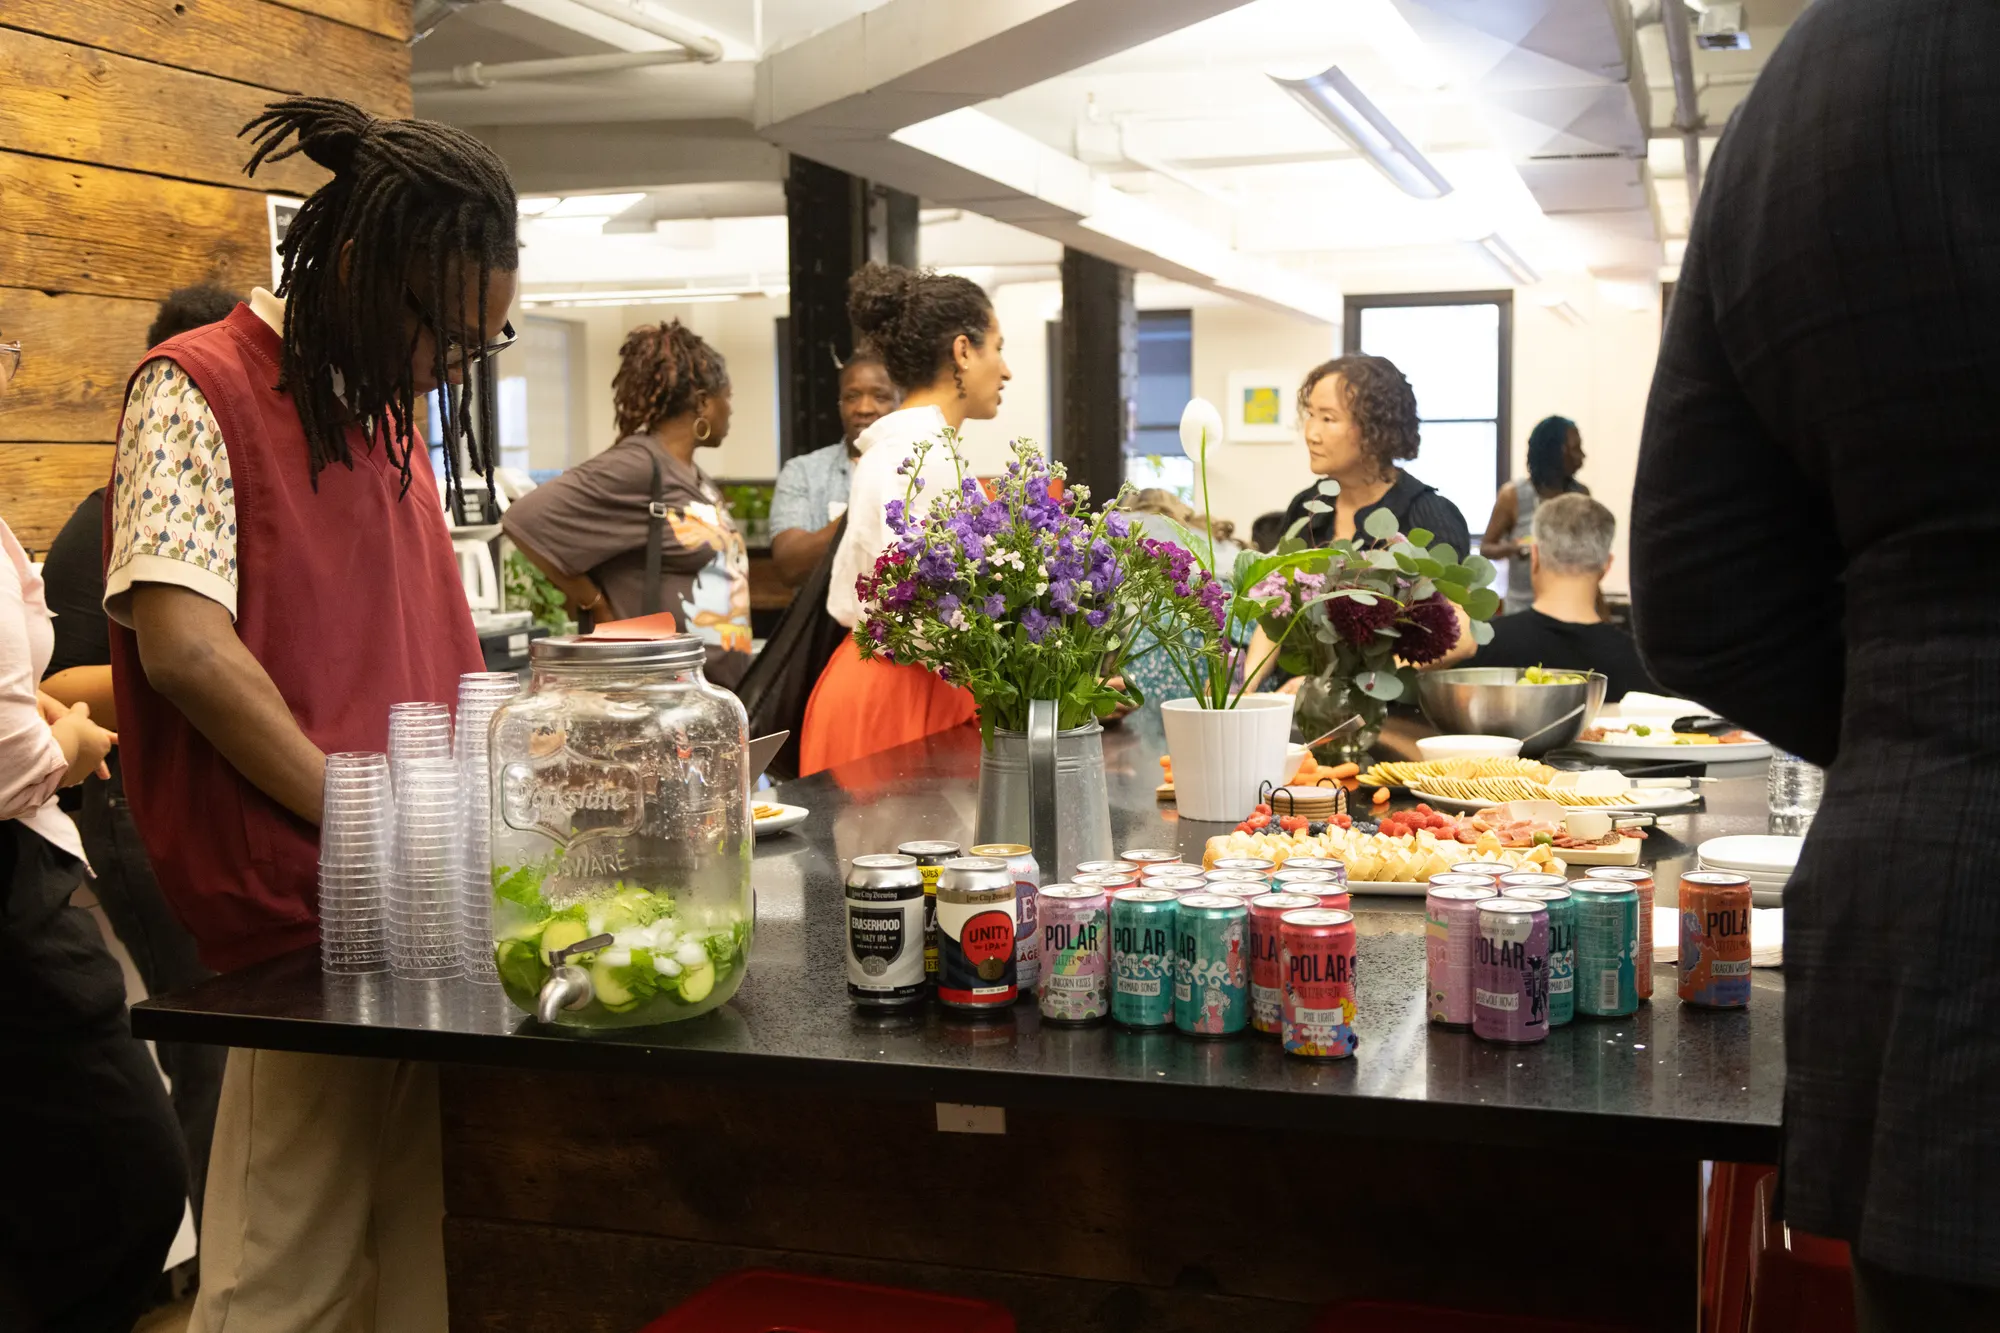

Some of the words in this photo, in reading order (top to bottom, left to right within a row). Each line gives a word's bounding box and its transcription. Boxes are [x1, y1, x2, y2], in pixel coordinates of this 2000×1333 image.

[516, 778, 630, 811] Yorkshire
[851, 917, 900, 931] ERASERHOOD
[877, 934, 887, 942] IPA
[969, 925, 1010, 943] UNITY
[1045, 923, 1098, 951] POLAR
[1707, 909, 1748, 938] POLA
[984, 943, 1000, 951] IPA
[1115, 926, 1166, 956] POLAR
[1250, 932, 1279, 963] OLA
[1474, 937, 1525, 970] POLAR
[1548, 925, 1572, 954] OLA
[1290, 953, 1348, 983] POLAR
[1712, 963, 1734, 974] DRAGON
